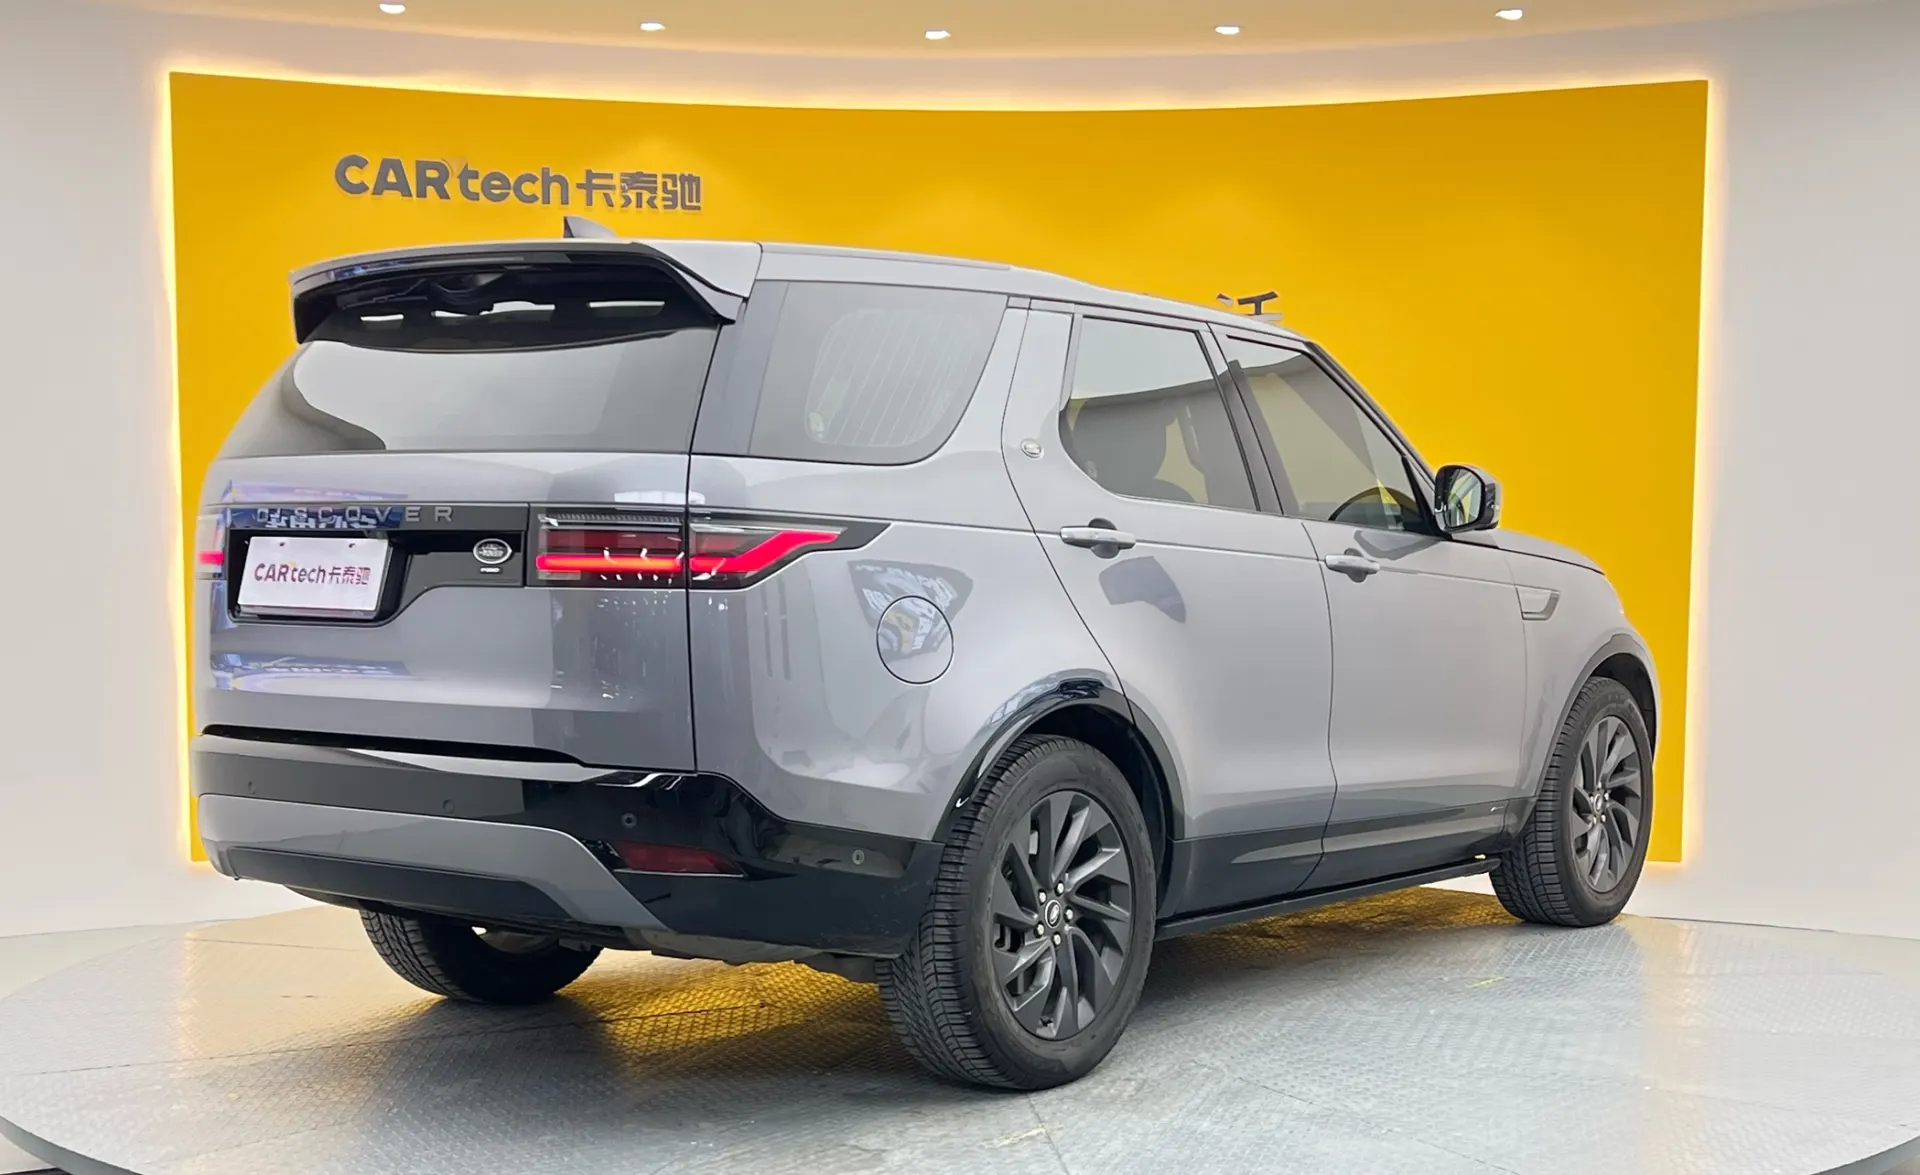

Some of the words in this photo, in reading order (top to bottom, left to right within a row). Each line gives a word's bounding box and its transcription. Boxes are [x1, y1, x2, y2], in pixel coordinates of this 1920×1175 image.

[334, 154, 569, 206] CARtech
[576, 168, 702, 211] 卡泰驰
[254, 562, 326, 584] CARtech
